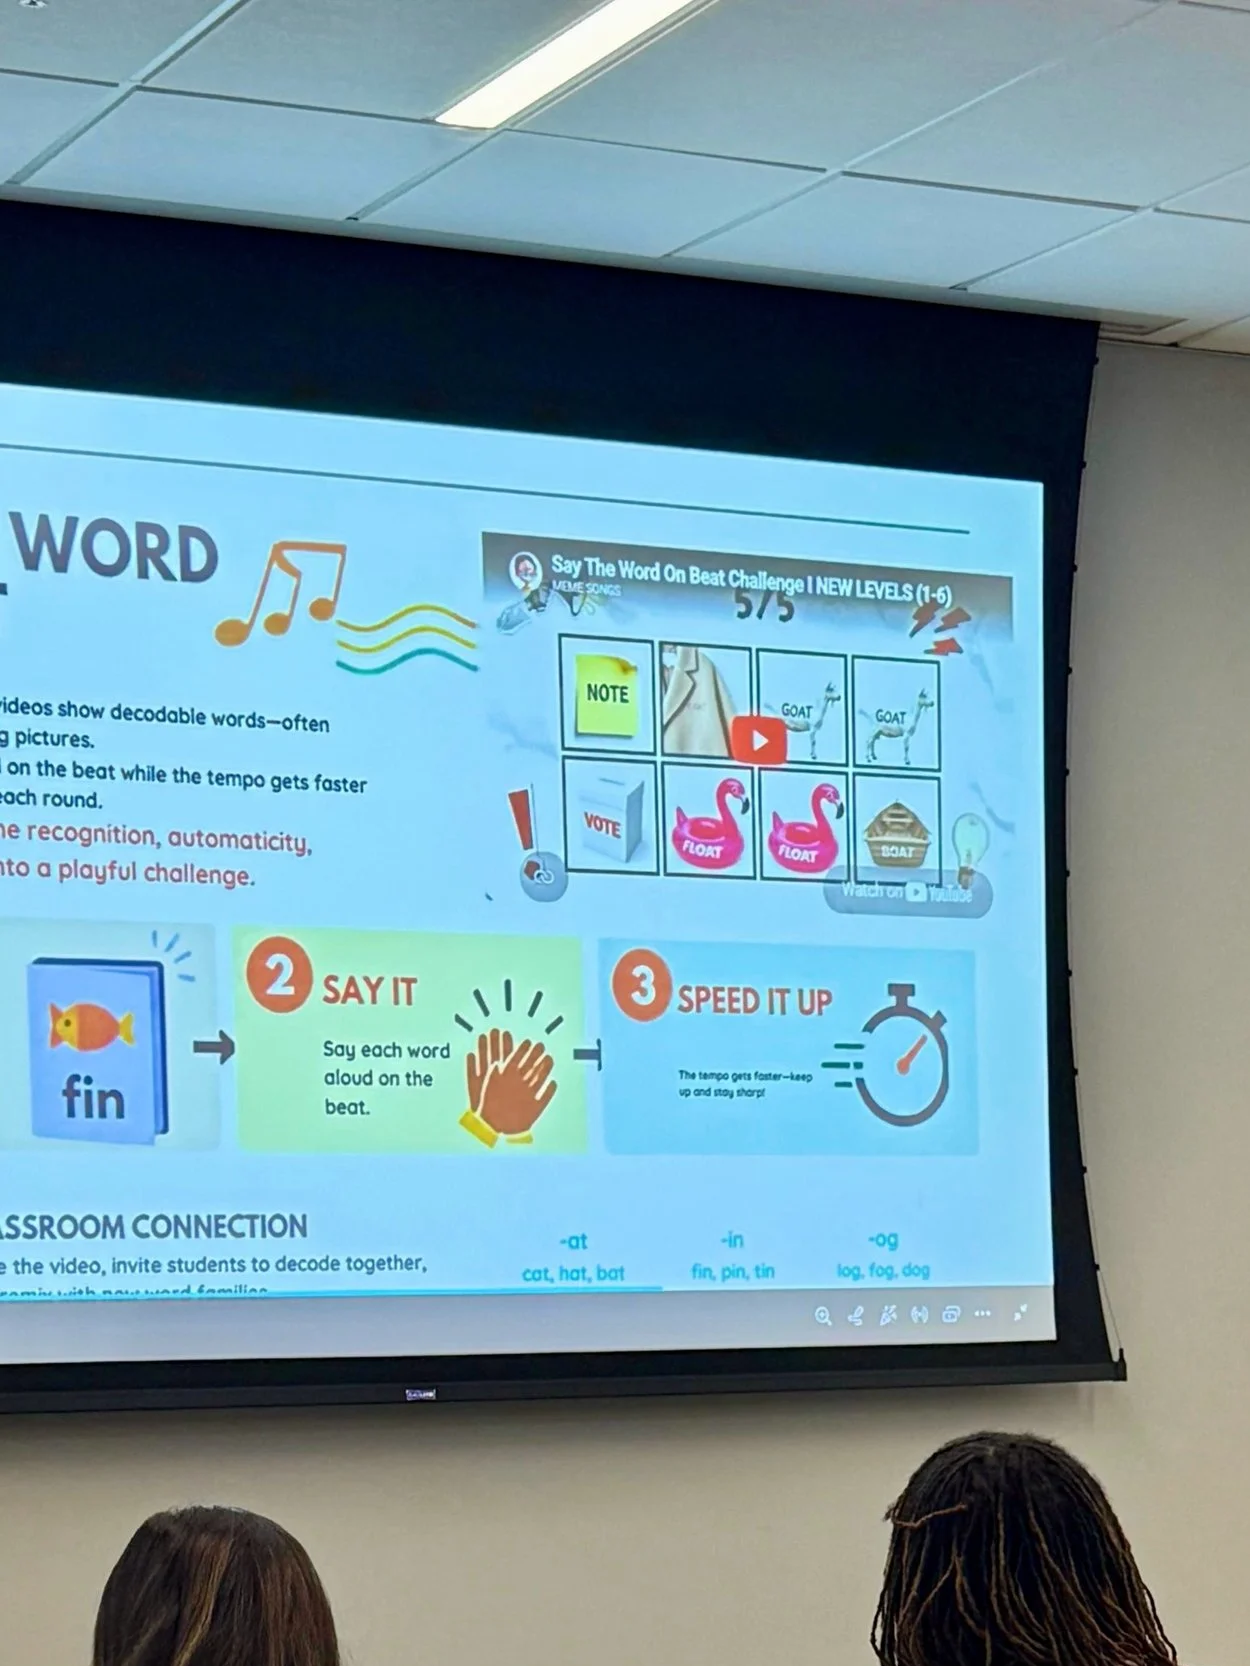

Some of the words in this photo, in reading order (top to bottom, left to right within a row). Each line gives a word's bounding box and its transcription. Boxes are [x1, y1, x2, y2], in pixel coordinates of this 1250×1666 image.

[9, 511, 219, 583] WORD
[551, 554, 582, 579] Say
[584, 557, 616, 578] The
[618, 560, 661, 581] Word
[664, 563, 686, 583] On
[689, 566, 726, 587] Beat
[728, 568, 805, 596] Challenge
[816, 576, 853, 597] NEW
[856, 579, 914, 602] LEVELS
[916, 583, 953, 608] (1-6)
[552, 580, 585, 594] MEME
[585, 582, 623, 597] SONGS
[734, 588, 795, 623] 5/5
[587, 683, 629, 704] NOTE
[0, 696, 53, 717] ideos
[58, 700, 105, 719] show
[111, 703, 206, 725] decodable
[781, 702, 814, 719] GOAT
[875, 708, 907, 725] GOAT
[15, 728, 95, 749] pictures.
[7, 761, 31, 776] on
[36, 760, 67, 777] the
[72, 761, 116, 780] beat
[121, 764, 167, 783] while
[172, 766, 201, 785] the
[207, 770, 266, 791] tempo
[270, 774, 310, 793] gets
[314, 774, 368, 794] faster
[43, 791, 103, 810] round.
[584, 811, 622, 840] VOTE
[27, 823, 162, 850] recognition,
[168, 829, 313, 858] automaticity,
[682, 839, 723, 859] FLOAT
[778, 844, 819, 863] FLOAT
[37, 862, 51, 878] a
[59, 858, 137, 885] playful
[144, 861, 256, 891] challenge.
[842, 881, 884, 898] Watch
[886, 887, 903, 899] on
[265, 953, 296, 996] 2
[631, 964, 657, 1006] 3
[322, 974, 385, 1005] SAY
[393, 977, 418, 1006] IT
[677, 985, 760, 1014] SPEED
[768, 987, 791, 1016] IT
[798, 988, 833, 1016] UP
[323, 1040, 356, 1061] Say
[361, 1042, 402, 1059] each
[407, 1043, 451, 1059] word
[324, 1069, 373, 1087] aloud
[378, 1072, 400, 1087] on
[405, 1070, 433, 1087] the
[678, 1070, 697, 1080] The
[698, 1071, 730, 1082] tempo
[731, 1071, 752, 1083] gets
[62, 1074, 126, 1120] fin
[679, 1088, 691, 1098] up
[693, 1087, 712, 1097] and
[713, 1087, 734, 1099] stay
[325, 1098, 371, 1115] beat.
[0, 1213, 126, 1241] SSROOM
[132, 1213, 308, 1240] CONNECTION
[560, 1233, 588, 1250] -at
[721, 1230, 744, 1248] -in
[868, 1232, 899, 1251] -og
[13, 1257, 44, 1275] the
[50, 1257, 106, 1276] video,
[112, 1256, 162, 1274] invite
[167, 1256, 247, 1274] students
[251, 1257, 270, 1273] to
[275, 1255, 340, 1273] decode
[346, 1254, 428, 1275] together,
[522, 1266, 555, 1283] cat,
[559, 1265, 592, 1283] hat,
[596, 1264, 625, 1281] bat
[692, 1262, 716, 1281] fin,
[721, 1262, 750, 1282] pin,
[754, 1262, 775, 1279] tin
[837, 1262, 865, 1281] log,
[869, 1262, 899, 1281] fog,
[902, 1262, 930, 1281] dog
